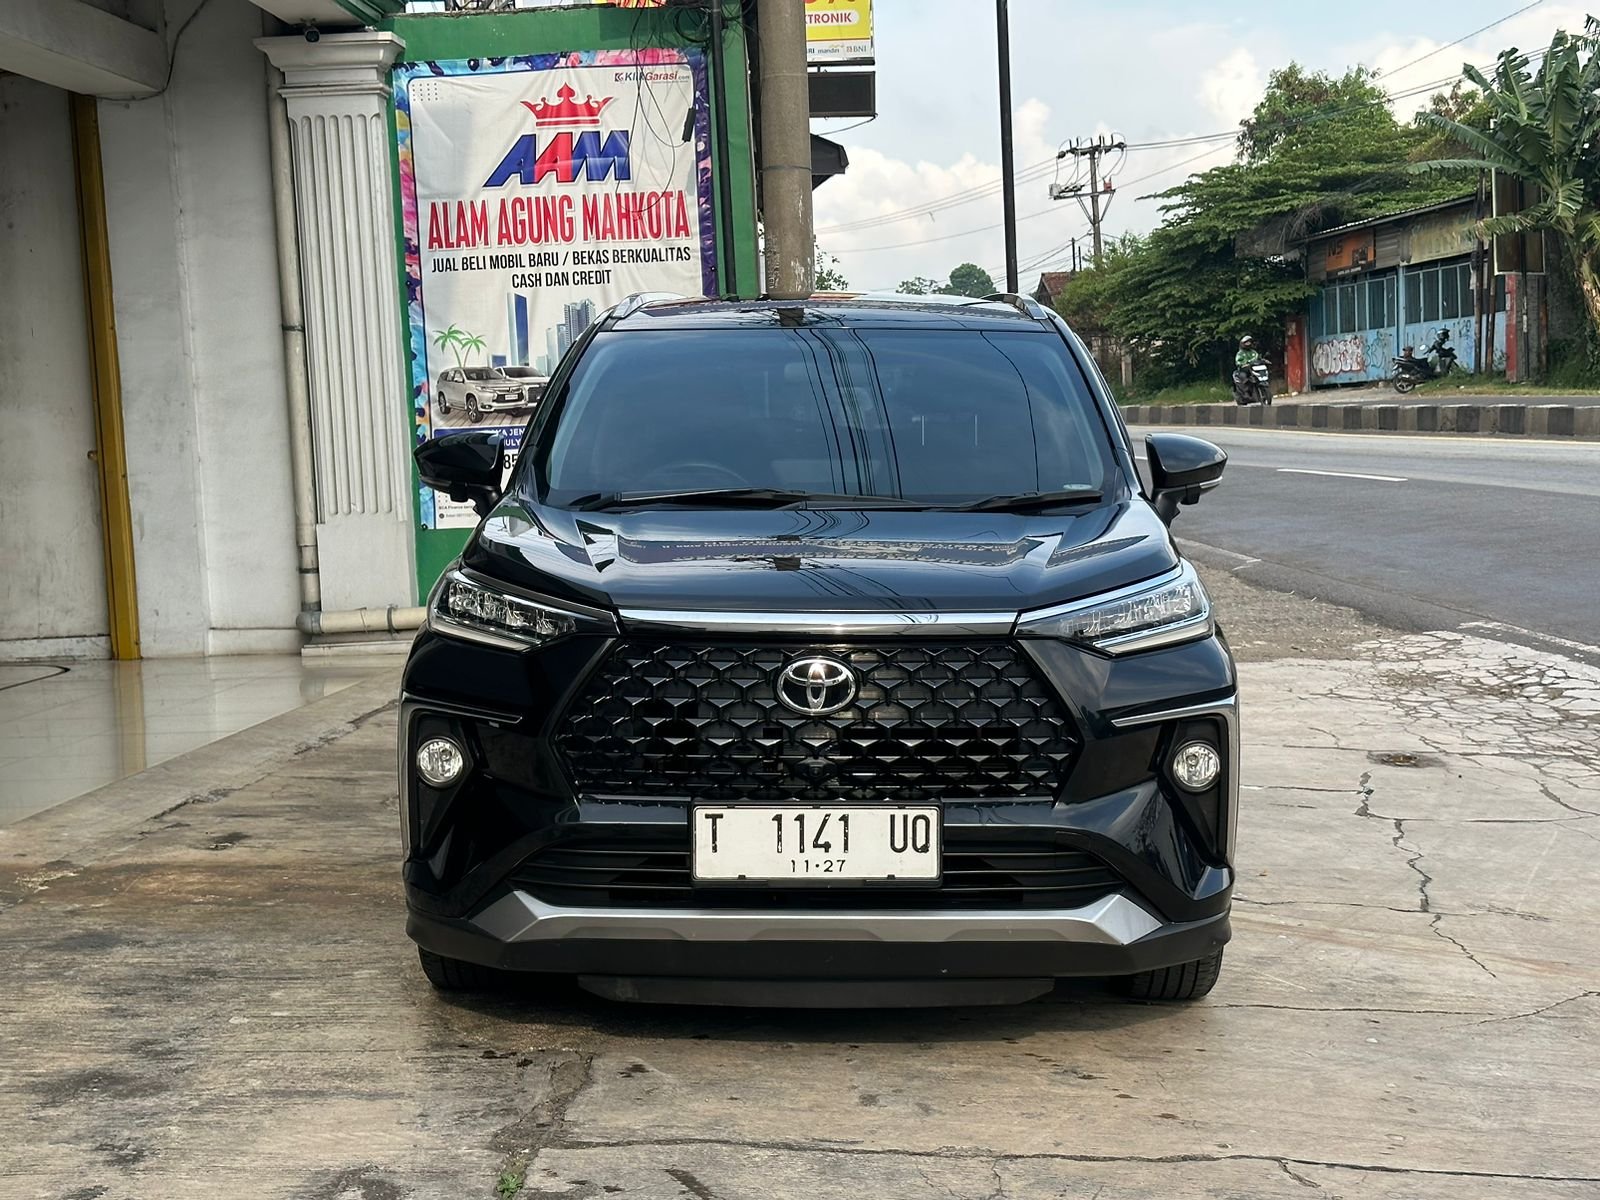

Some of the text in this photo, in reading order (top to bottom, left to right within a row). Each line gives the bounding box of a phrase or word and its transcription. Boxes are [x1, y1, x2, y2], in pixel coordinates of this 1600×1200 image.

[805, 12, 852, 24] TRONIK
[853, 45, 867, 53] BNI
[483, 129, 631, 188] AAM
[428, 190, 690, 249] ALAM AGUNG MAHKOTA
[432, 258, 459, 273] JUAL
[461, 255, 486, 271] BELI
[489, 253, 526, 270] MOBIL
[528, 251, 559, 268] BARU
[572, 249, 610, 266] BEKAS
[612, 246, 691, 264] BERKUALITAS
[512, 269, 612, 289] CASH DAN CREDIT
[704, 813, 931, 853] T 1141 UQ
